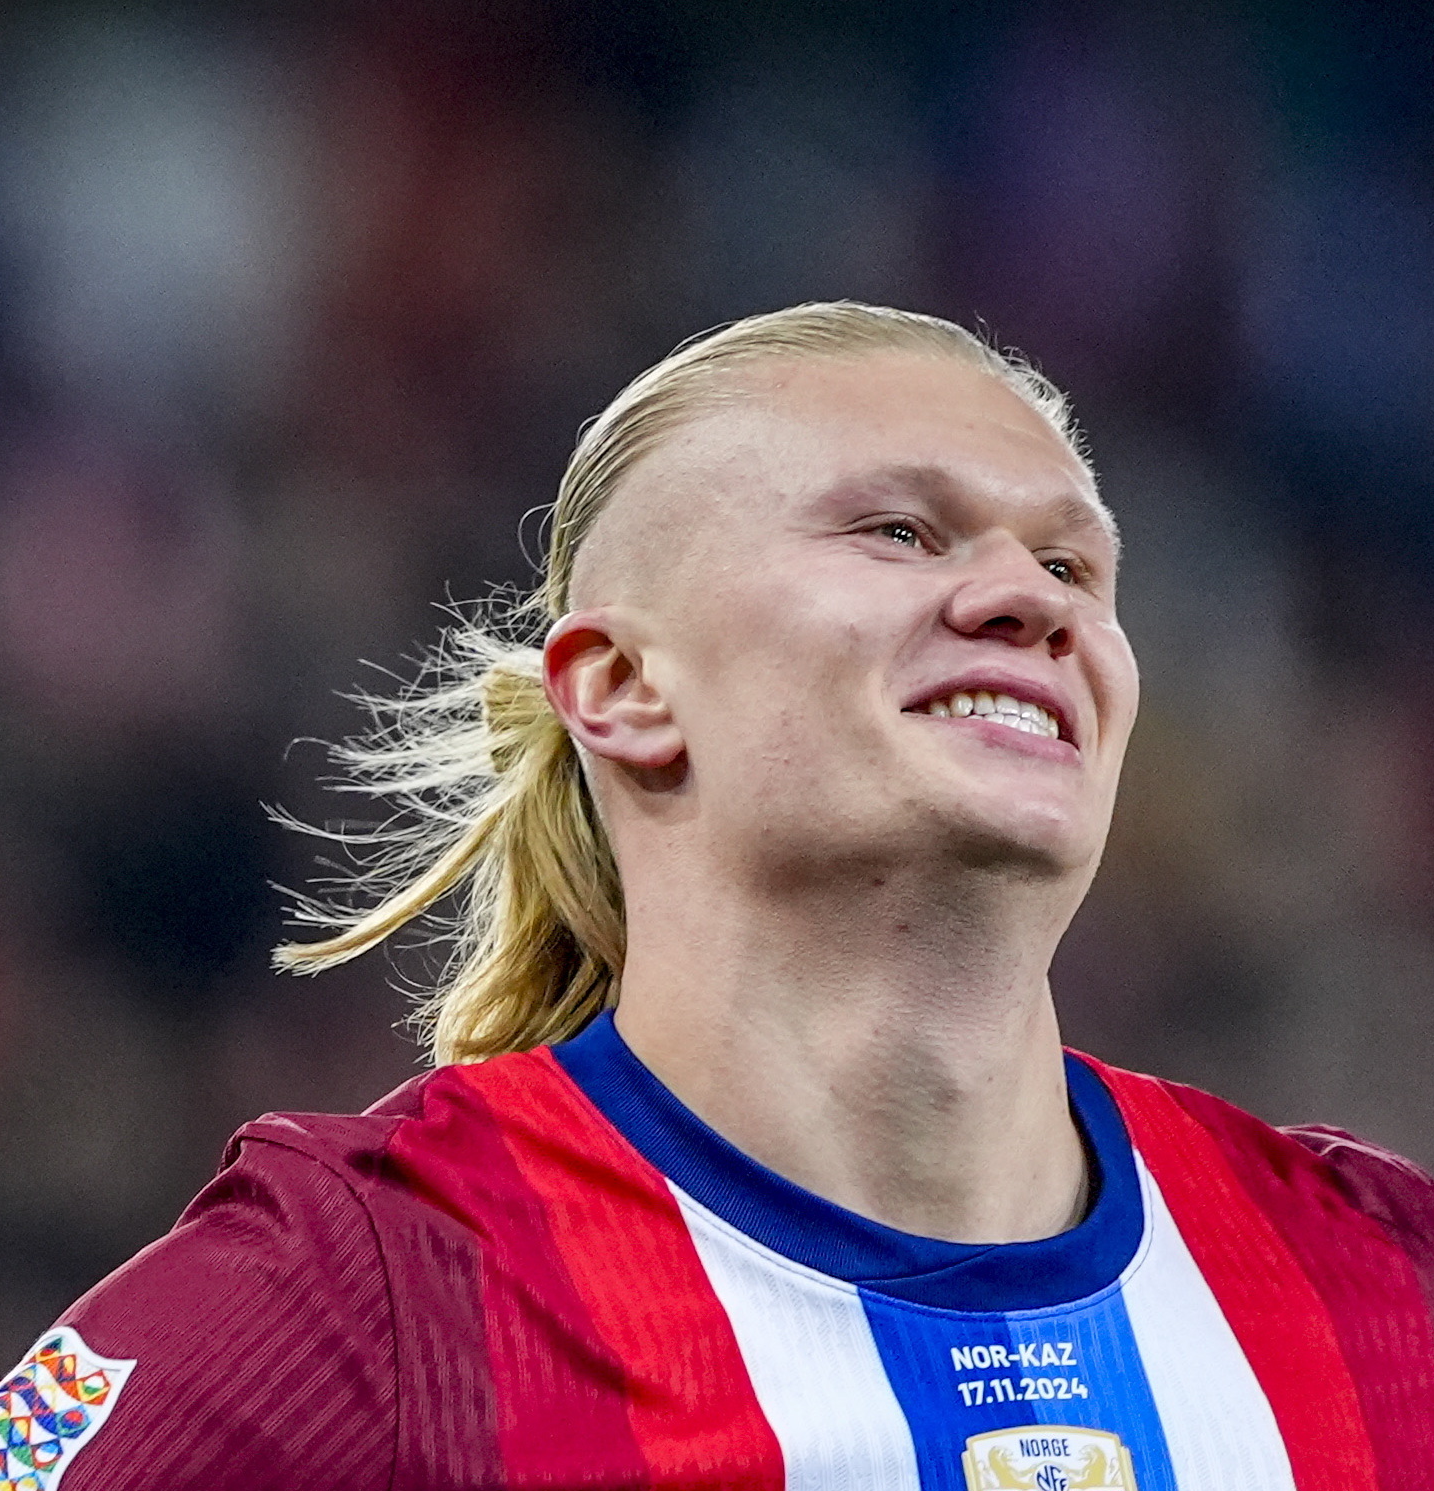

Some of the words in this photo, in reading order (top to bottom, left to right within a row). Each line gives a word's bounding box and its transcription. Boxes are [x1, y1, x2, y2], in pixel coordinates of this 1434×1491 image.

[950, 1342, 1077, 1371] NOR-KAZ
[957, 1377, 1088, 1407] 17.11.2024
[1019, 1438, 1071, 1457] NORGE
